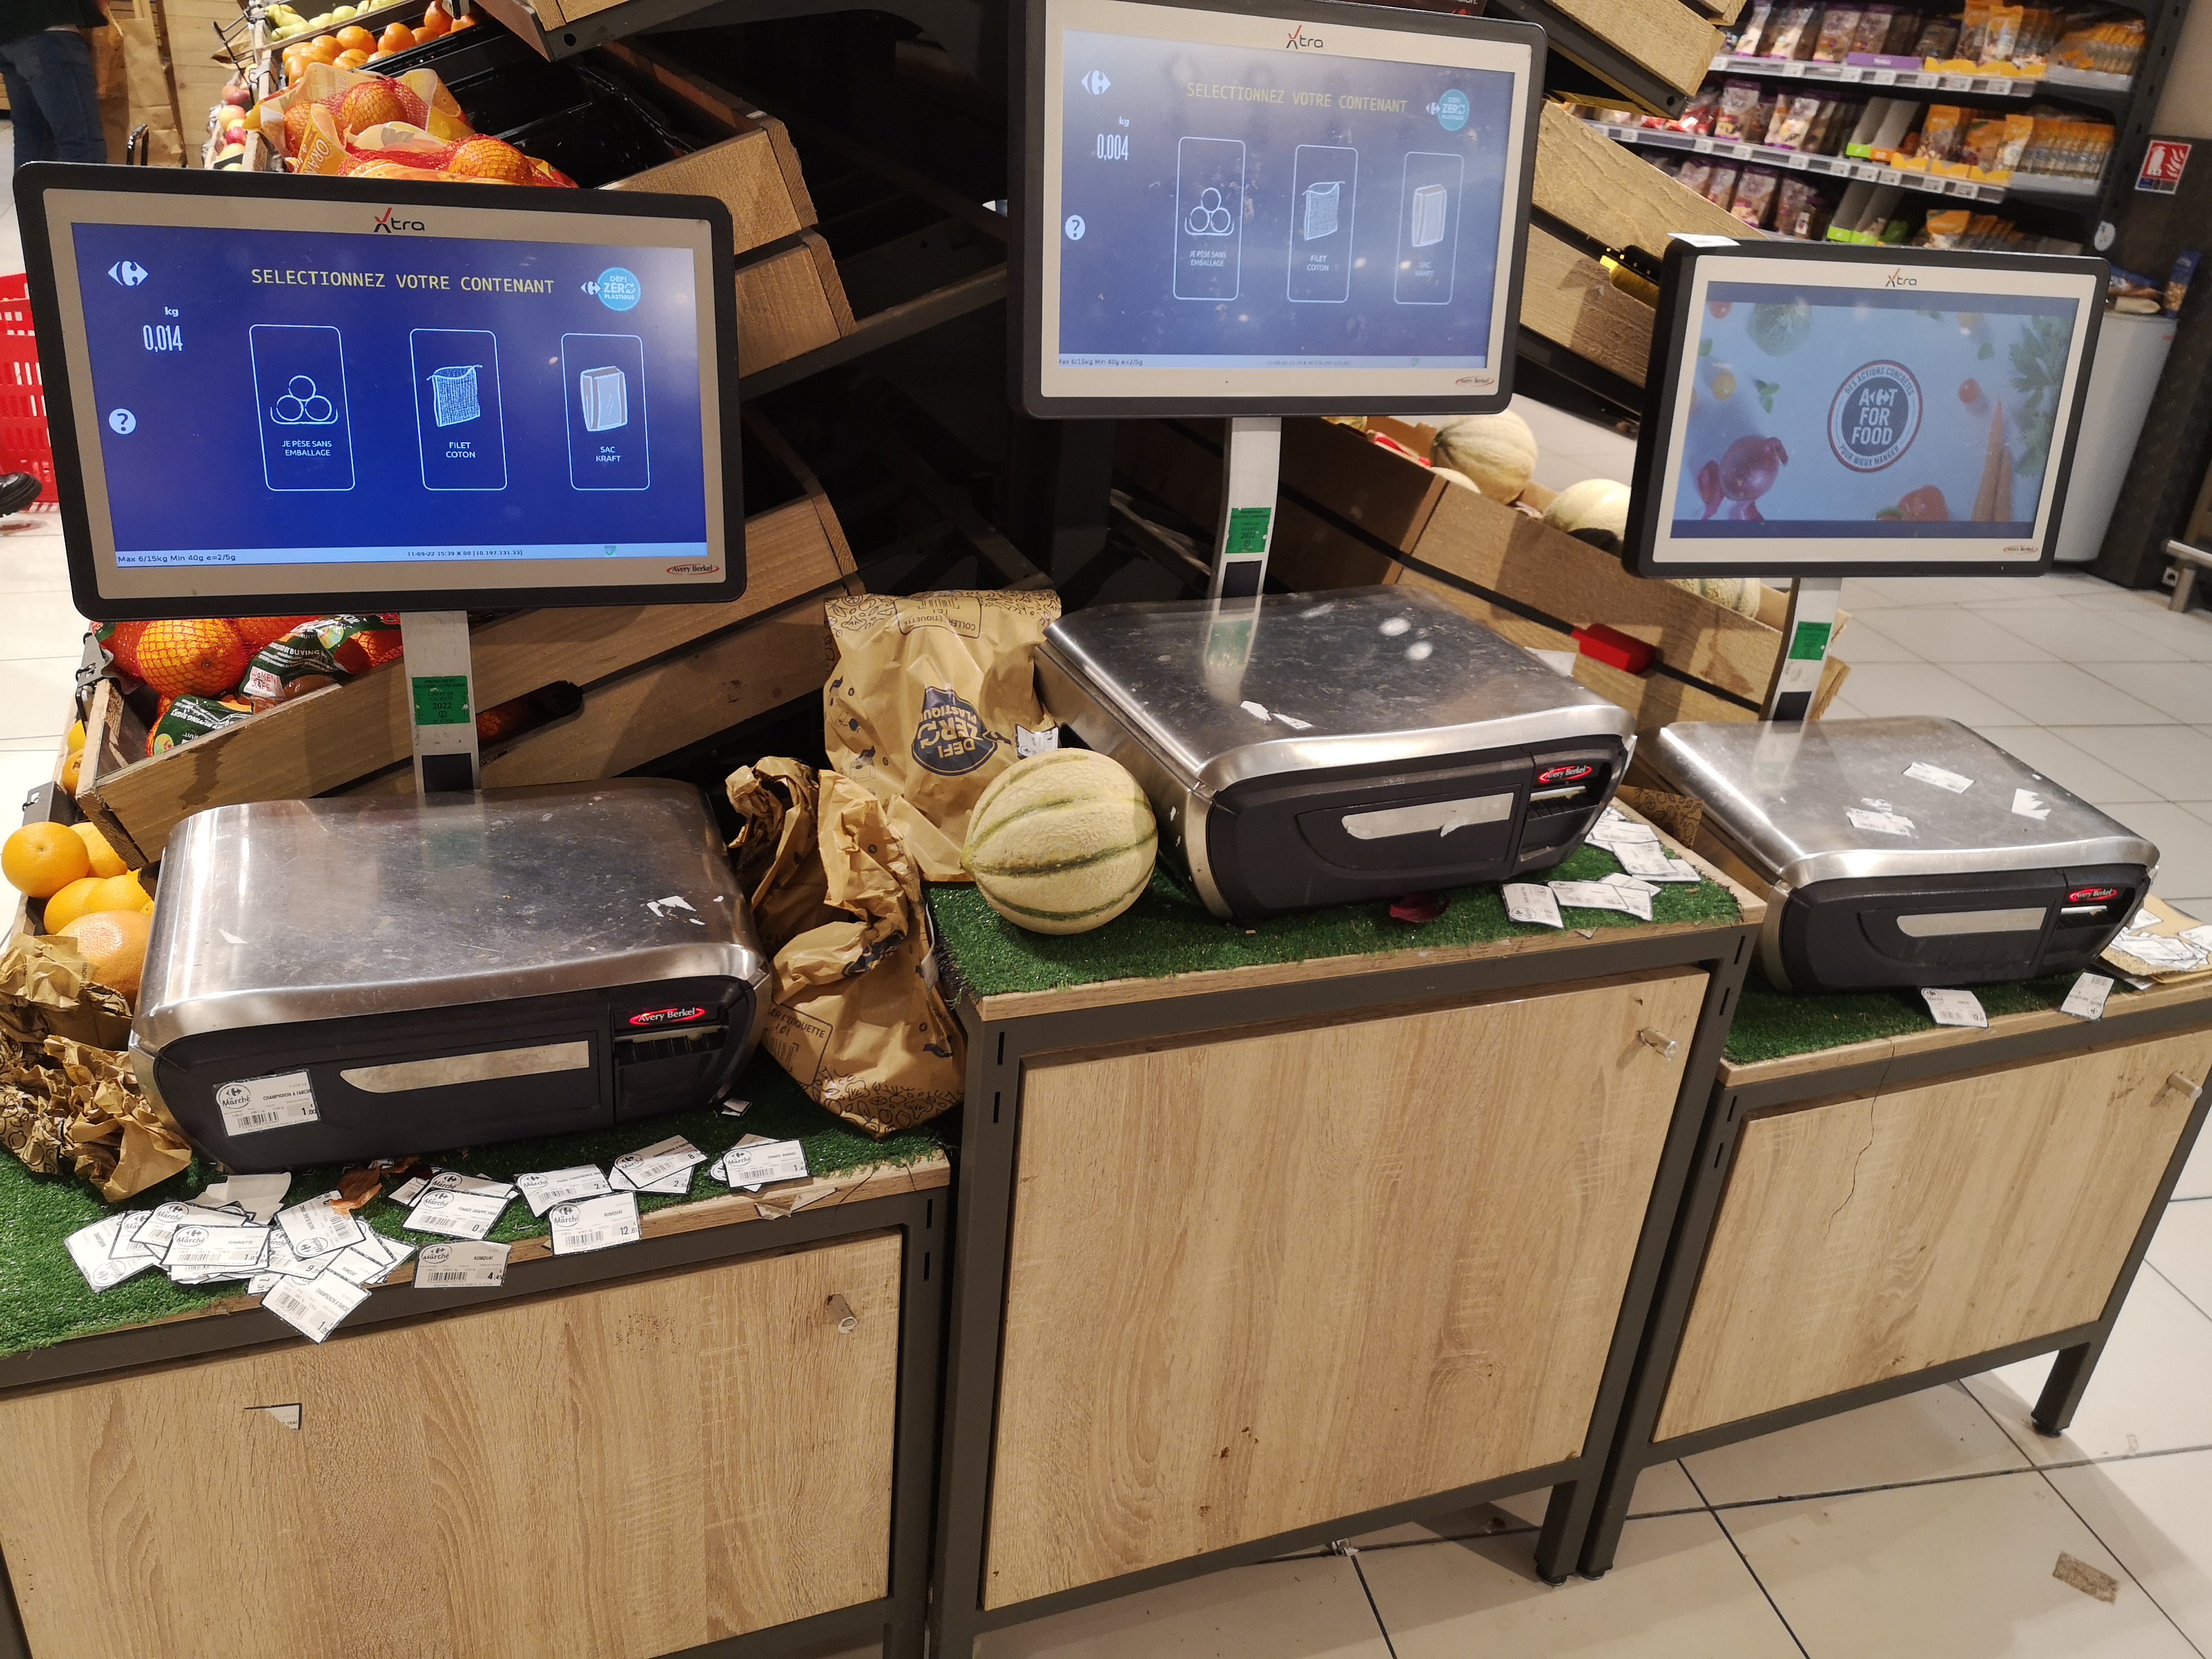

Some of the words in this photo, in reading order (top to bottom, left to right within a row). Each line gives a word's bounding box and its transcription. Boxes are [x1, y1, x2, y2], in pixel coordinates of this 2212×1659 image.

[1286, 25, 1323, 49] Xtra
[1187, 83, 1284, 104] SELECTIONNEZ
[1293, 92, 1331, 107] VOTRE
[1339, 95, 1408, 113] CONTENANT
[1119, 117, 1129, 127] kg
[1097, 133, 1129, 161] 0,004
[373, 207, 425, 233] Xtra
[1310, 255, 1327, 263] FILET
[1307, 263, 1330, 272] COTON
[251, 269, 385, 289] SELECTIONNEZ
[396, 274, 450, 290] VOTRE
[460, 276, 554, 294] CONTENANT
[1885, 268, 1917, 287] Xtra
[164, 307, 179, 317] kg
[143, 324, 183, 352] 0,014
[1860, 407, 1890, 426] FOR
[1851, 426, 1893, 445] FOOD
[672, 565, 691, 574] Avery
[692, 564, 714, 573] Berkel
[638, 1013, 664, 1022] Avery
[667, 1007, 695, 1018] Berkel
[775, 1023, 790, 1036] ICI
[222, 1095, 251, 1107] Marché
[263, 1093, 292, 1101] CHAMPIGNON
[621, 1157, 645, 1170] Marché
[728, 1156, 752, 1165] Marché
[432, 1181, 458, 1190] Marché
[523, 1180, 549, 1189] Marché
[424, 1198, 449, 1207] Marché
[156, 1211, 184, 1221] Marché
[554, 1215, 580, 1224] Marché
[316, 1288, 336, 1303] CHAMPIGNON
